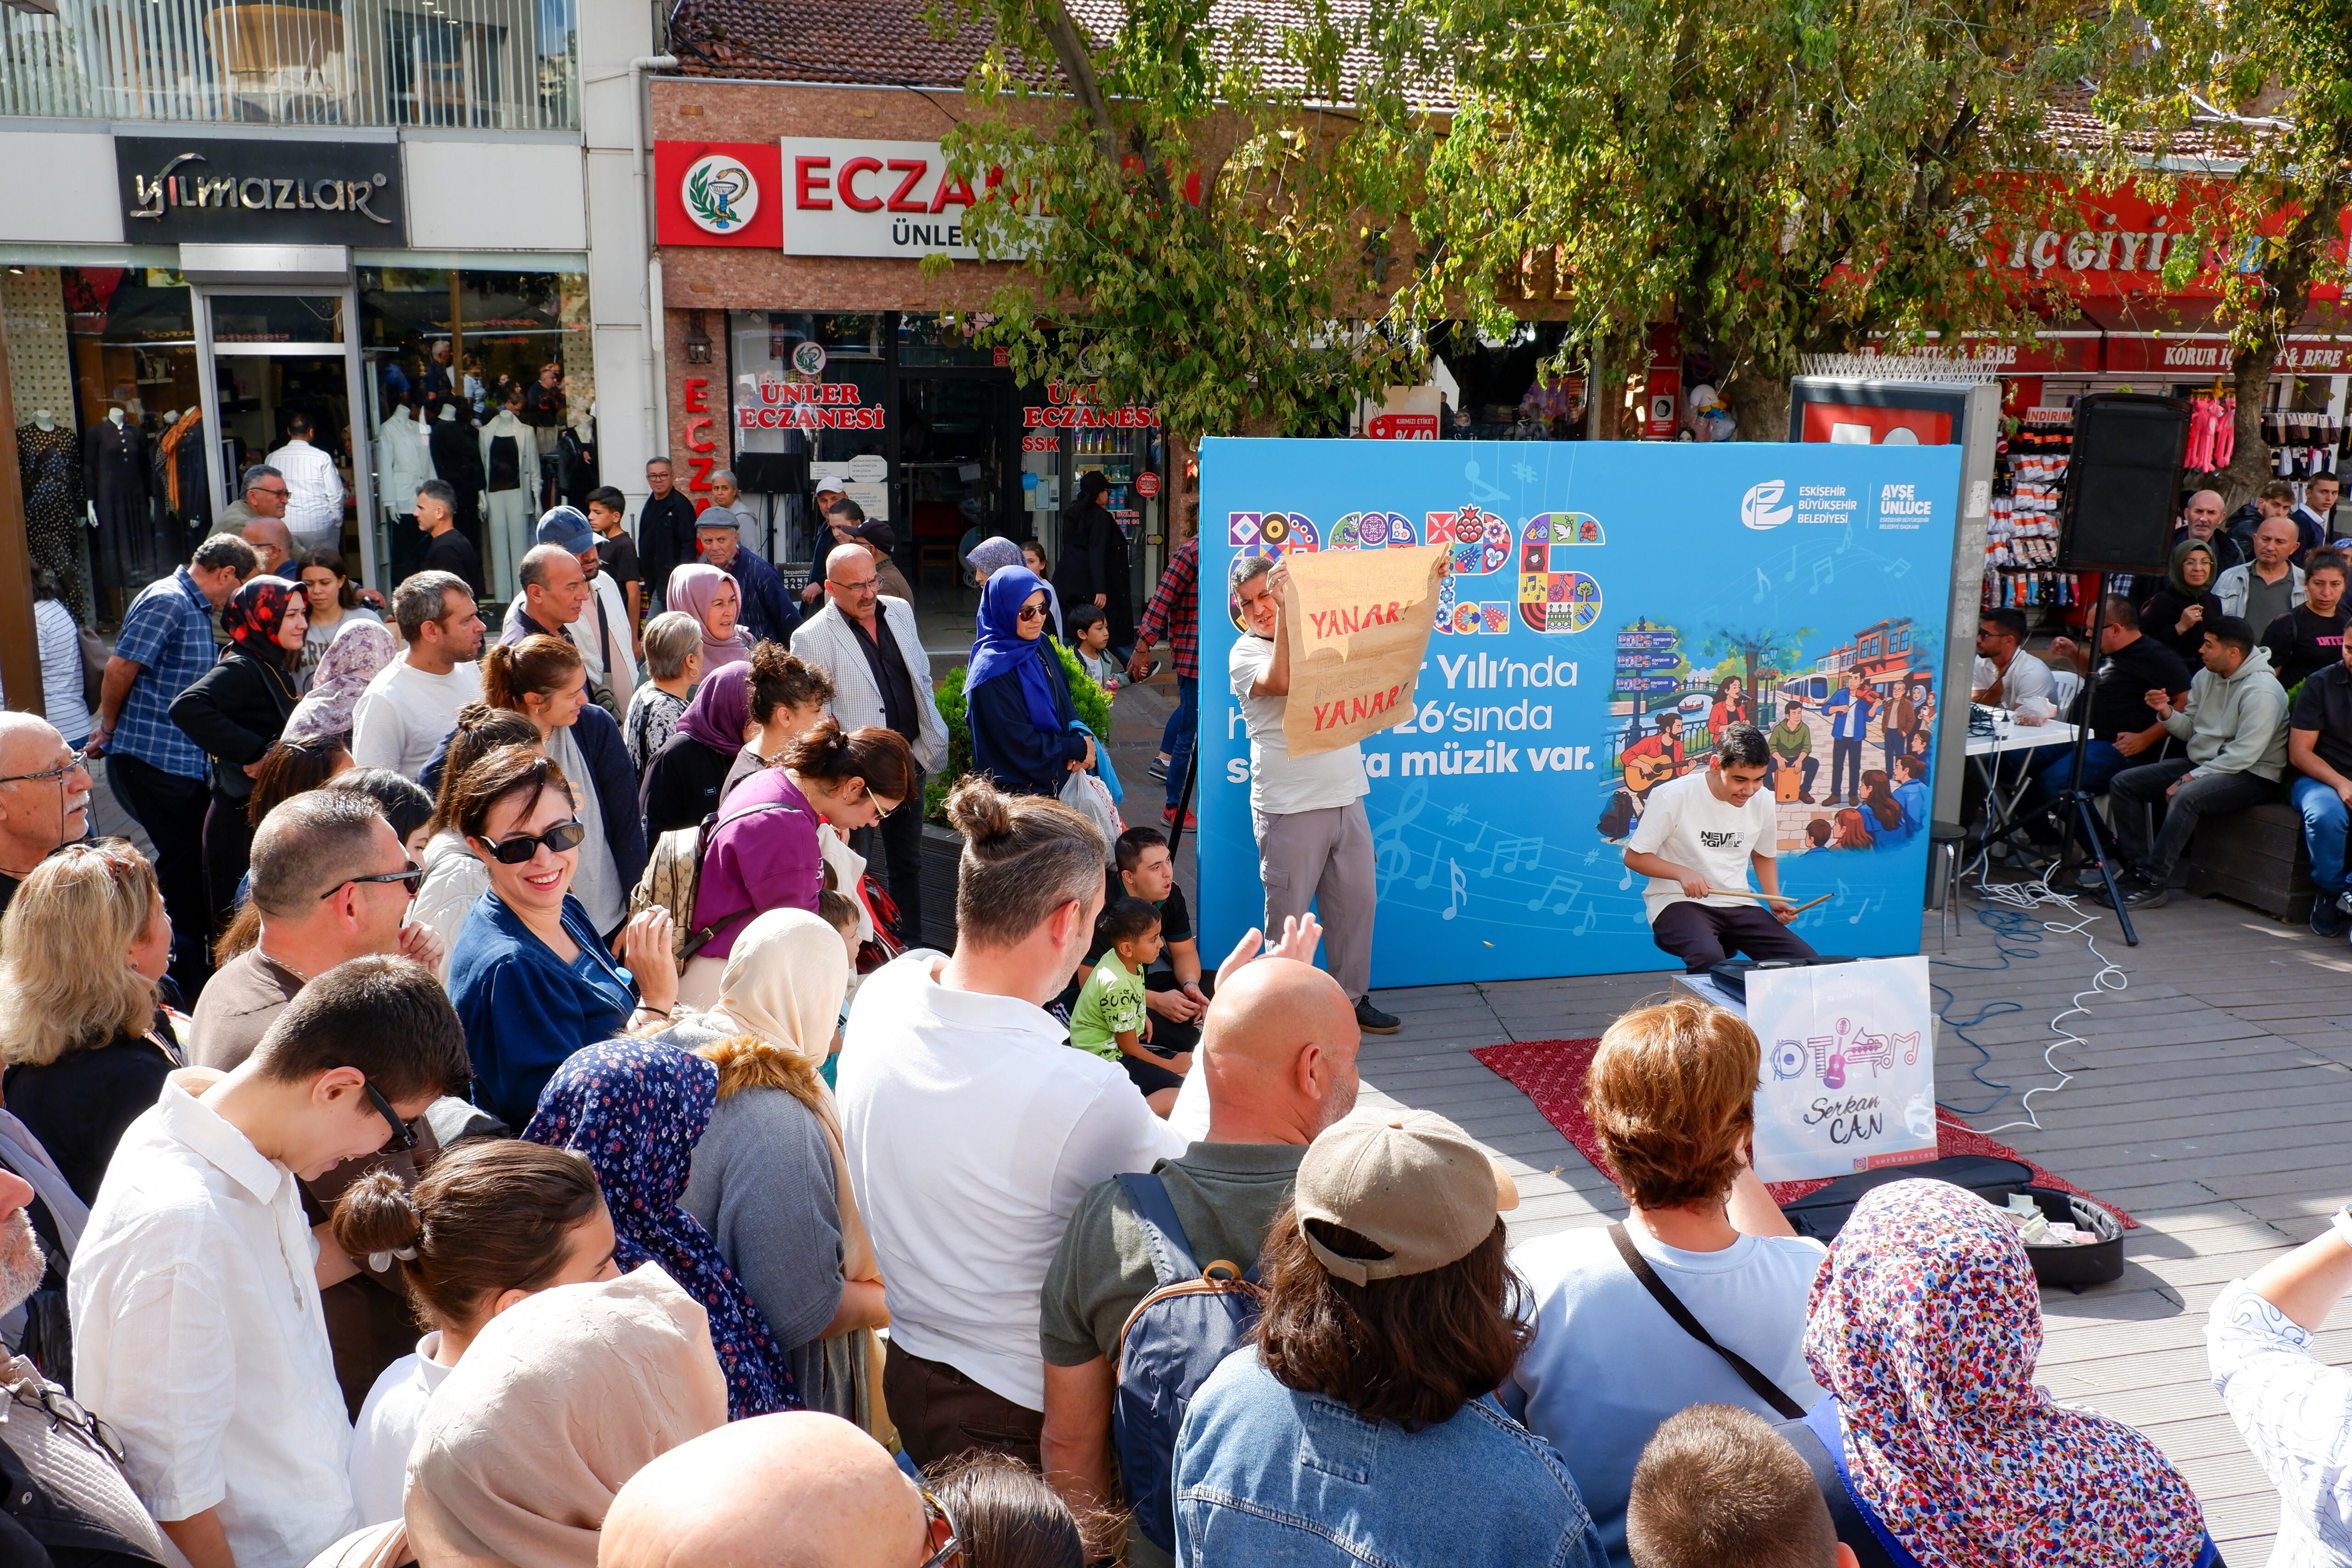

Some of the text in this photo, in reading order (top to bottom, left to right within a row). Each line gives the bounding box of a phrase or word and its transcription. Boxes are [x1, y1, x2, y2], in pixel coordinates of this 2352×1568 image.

[1974, 345, 2017, 364] EBE
[2164, 346, 2217, 366] KORUR
[2302, 349, 2343, 368] BEBE
[759, 379, 861, 405] ÜNLER
[738, 403, 885, 430] ECZANESİ
[2027, 408, 2071, 421] İNDİRİM
[1022, 436, 1060, 453] SSK
[1799, 485, 1846, 498] ESKİŞEHİR
[1881, 484, 1915, 501] AYŞE
[1798, 498, 1857, 511] BÜYÜKŞEHİR
[1880, 497, 1932, 515] ÜNLÜCE
[1797, 512, 1849, 524] BELEDİYESİ
[1309, 599, 1414, 639] YANAR!
[1317, 641, 1363, 674] HEM
[1436, 652, 1578, 689] Yılı'nda
[1315, 667, 1379, 700] NASIL
[1313, 681, 1409, 732] YANAR!
[1401, 739, 1519, 777] müzik
[1527, 746, 1595, 773] var.
[1700, 831, 1745, 844] NEVER
[1804, 1095, 1881, 1125] Serkan
[1829, 1112, 1883, 1144] CAN
